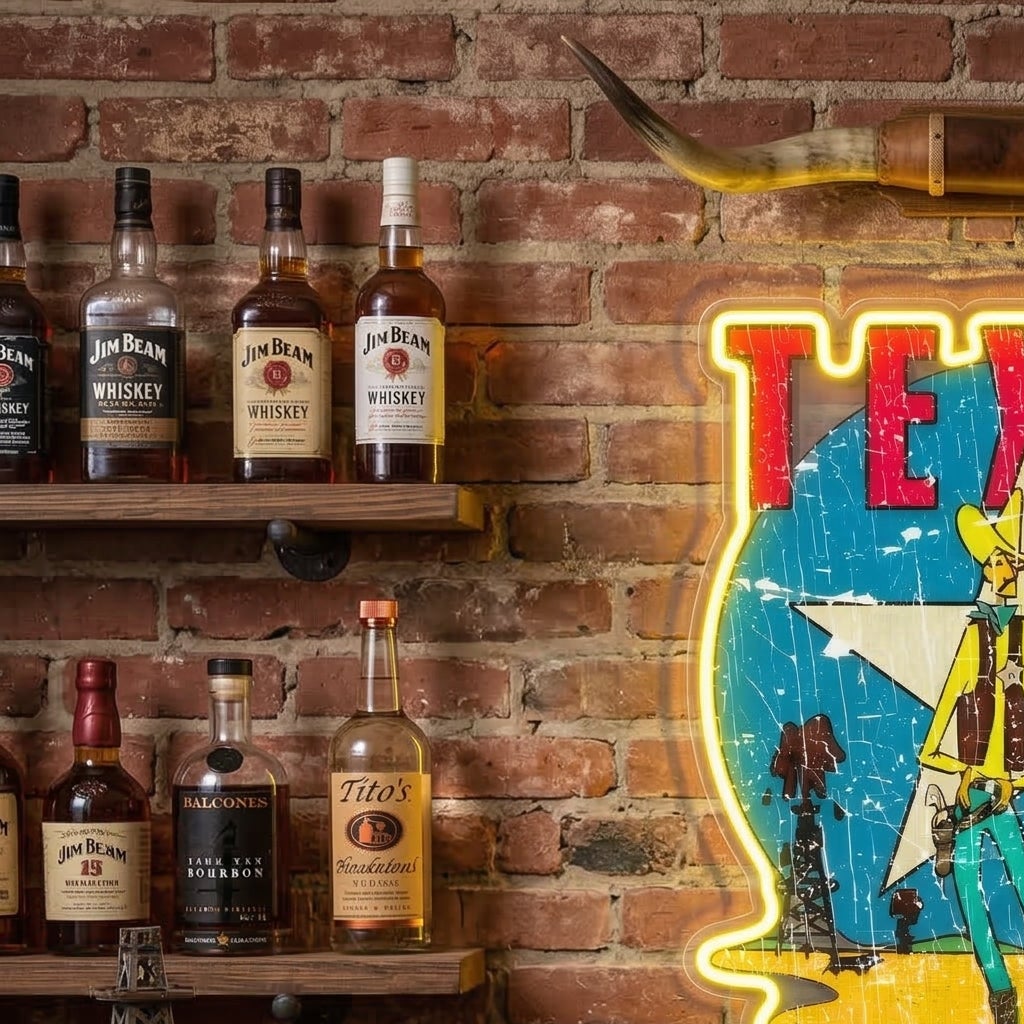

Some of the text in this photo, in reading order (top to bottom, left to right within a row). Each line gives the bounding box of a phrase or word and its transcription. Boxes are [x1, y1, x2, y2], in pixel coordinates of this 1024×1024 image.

[89, 333, 167, 367] JIM BEAM
[363, 326, 431, 357] JIM BEAM
[241, 337, 314, 370] JIM BEAM
[92, 382, 163, 400] WHISKEY
[368, 391, 426, 405] WHISKEY
[247, 405, 309, 419] WHISKEY
[183, 797, 268, 809] BALCONES
[58, 838, 127, 865] JIM BEAM
[187, 867, 264, 878] BOURBON
